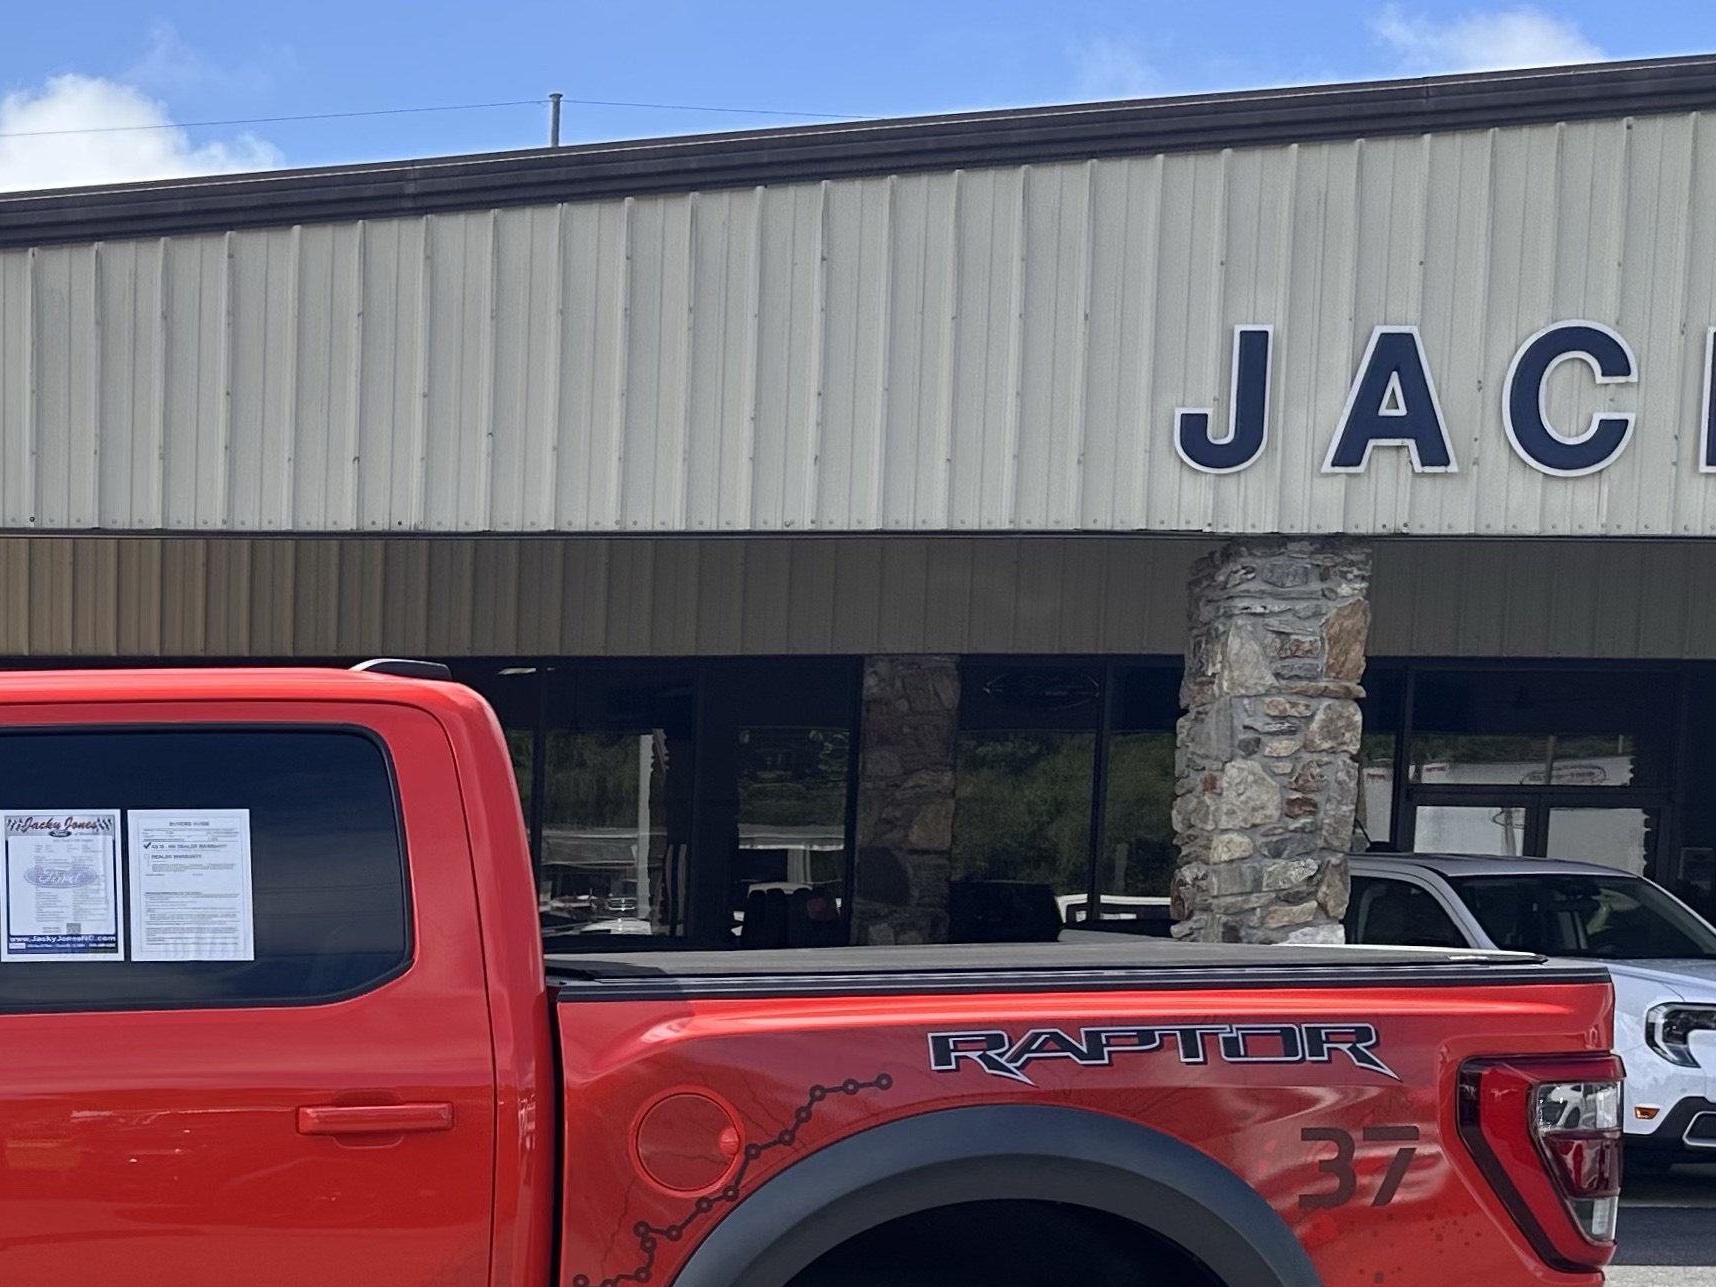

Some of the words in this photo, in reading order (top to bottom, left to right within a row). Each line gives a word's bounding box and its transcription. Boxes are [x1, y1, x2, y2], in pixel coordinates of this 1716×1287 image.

[20, 816, 60, 834] Jacky
[64, 816, 98, 832] Jones
[927, 1023, 1401, 1088] RAPTOR
[1299, 1125, 1420, 1209] 37
